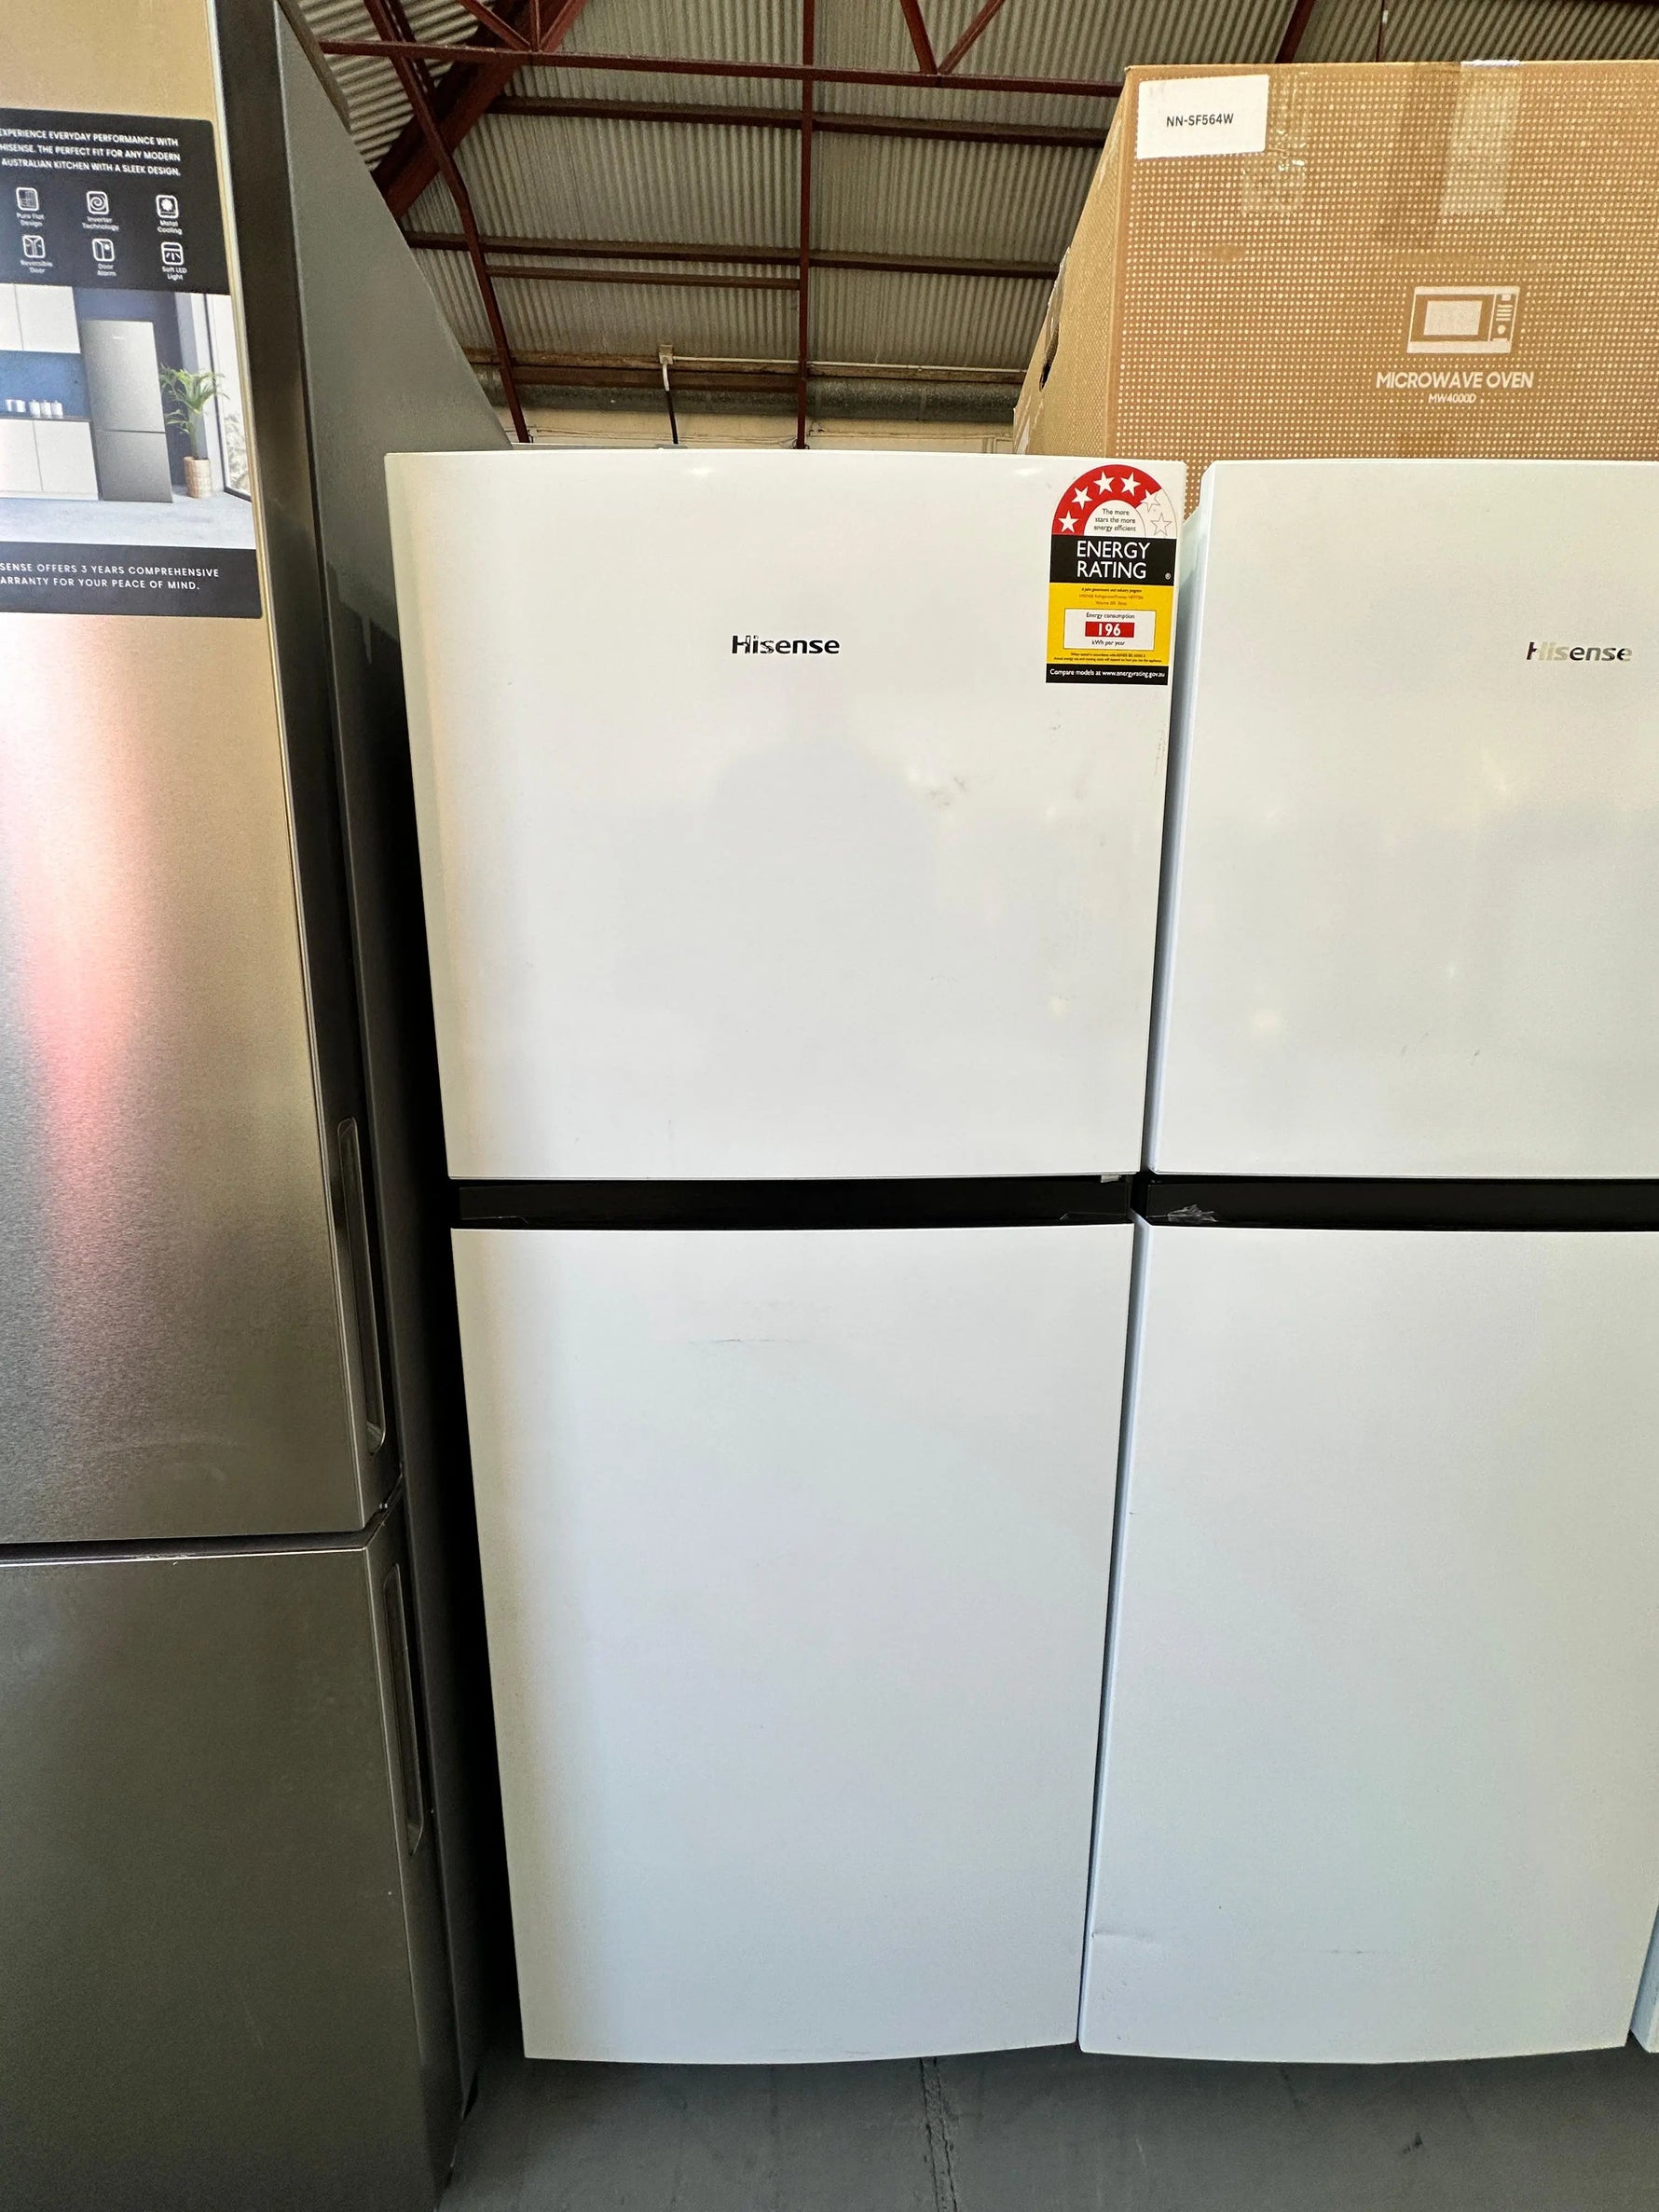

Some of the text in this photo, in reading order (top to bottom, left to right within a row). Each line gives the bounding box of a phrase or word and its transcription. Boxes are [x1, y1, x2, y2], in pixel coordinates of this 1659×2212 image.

[1166, 113, 1234, 128] NN-SF564W
[48, 131, 91, 141] EVERYDAY
[93, 133, 156, 145] PERFORMANCE
[157, 137, 179, 146] WITH
[37, 144, 54, 154] THE
[55, 145, 91, 156] PERFECT
[92, 148, 104, 157] FIT
[105, 149, 124, 158] FOR
[125, 150, 143, 159] ANY
[144, 151, 181, 161] MODERN
[1, 158, 182, 177] AUSTRALIAN KITCHEN WITH A SLEEK DESIGN.
[1376, 371, 1534, 389] MICROWAVE OVEN
[1428, 392, 1477, 404] MW4000D
[1076, 540, 1151, 559] ENERGY
[0, 562, 220, 578] SENSE OFFERS 3 YEARS COMPREHENSIVE
[1076, 561, 1146, 579] RATING
[0, 576, 200, 590] ARRANTY FOR YOUR PEACE OF MIND.
[1098, 623, 1121, 637] 196
[731, 635, 840, 654] Hisense
[1526, 641, 1633, 662] Hisense
[1049, 668, 1075, 677] Compare
